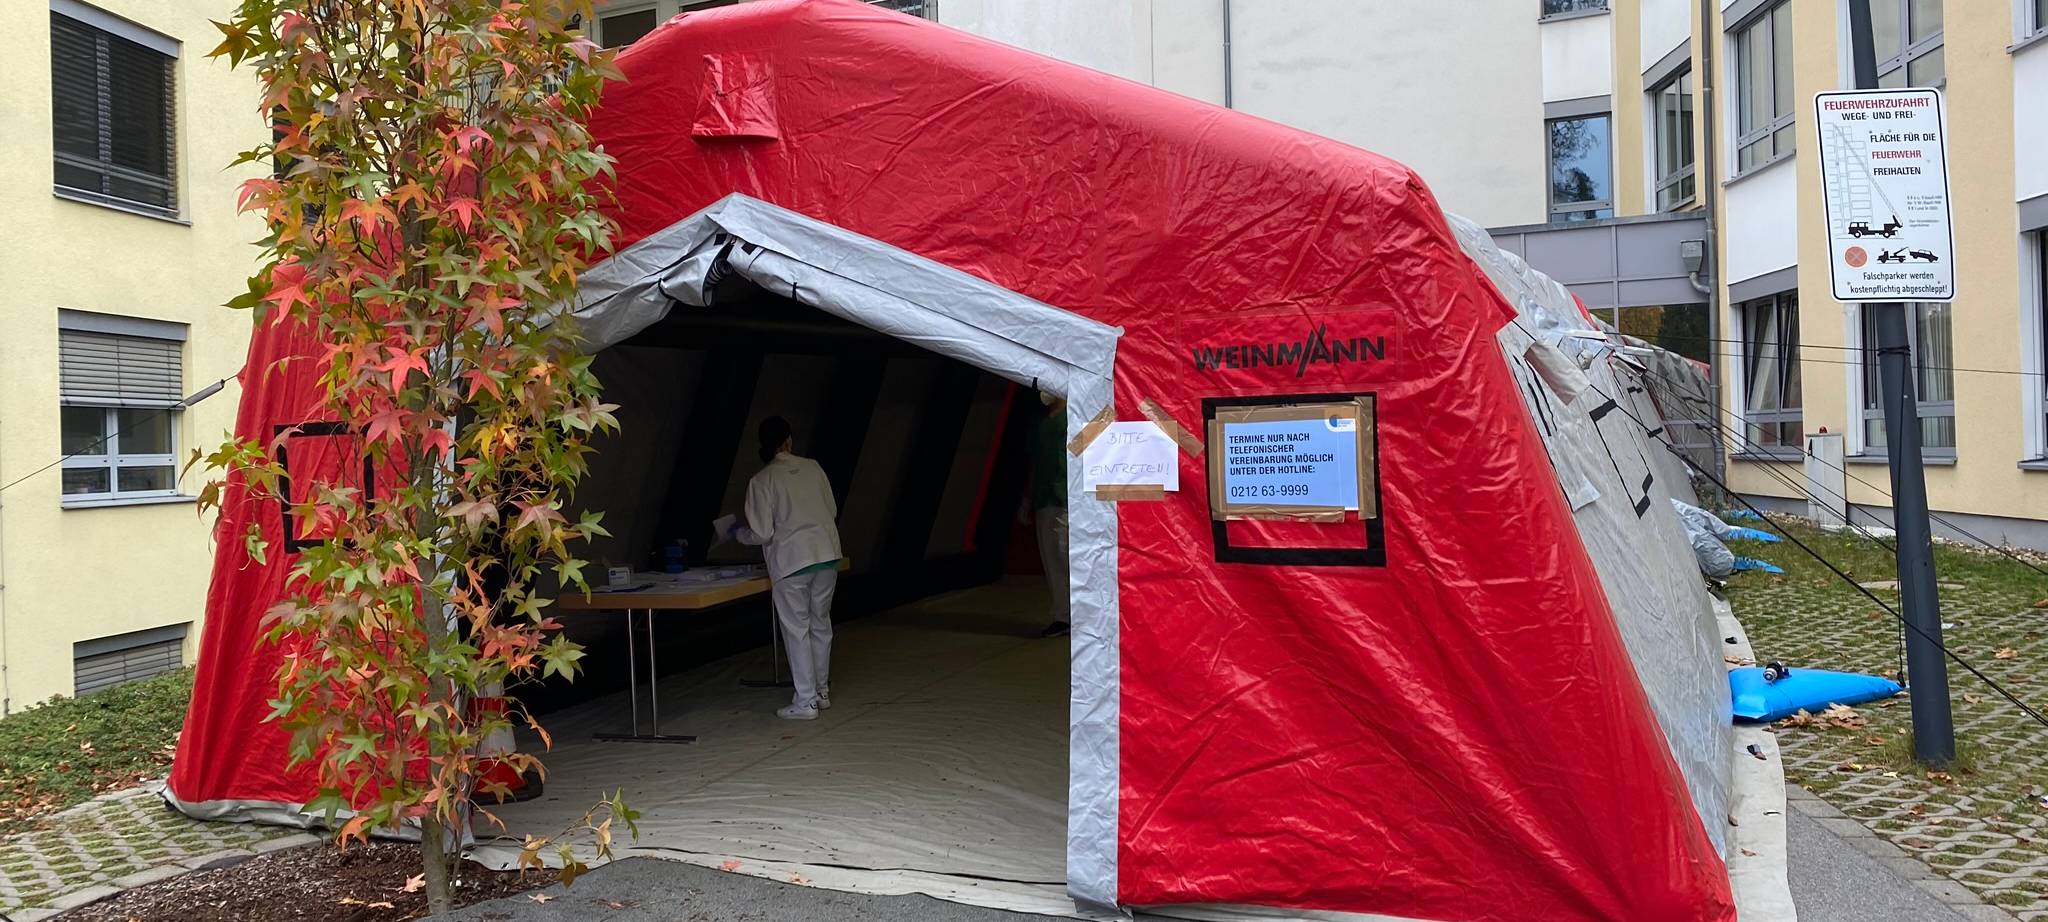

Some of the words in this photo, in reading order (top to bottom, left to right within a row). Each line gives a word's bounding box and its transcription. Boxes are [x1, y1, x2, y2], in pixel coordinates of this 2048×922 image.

[1824, 98, 1930, 110] FEUERWEHRZUFAHRT
[1841, 112, 1869, 120] WEGE-
[1872, 111, 1892, 120] UND
[1895, 111, 1917, 119] FREI-
[1870, 132, 1901, 143] FLÄCHE
[1903, 132, 1920, 142] FÜR
[1923, 133, 1936, 141] DIE
[1872, 150, 1922, 159] FEUERWEHR
[1873, 167, 1921, 176] FREIHALTEN
[1863, 272, 1907, 281] Falschparker
[1909, 272, 1934, 280] werden
[1850, 285, 1900, 294] kostenpflichtig
[1902, 284, 1948, 294] abgeschleppt!
[1192, 322, 1385, 378] WEINMANN
[1106, 432, 1148, 444] BITTE
[1229, 435, 1265, 444] TERMINE
[1267, 434, 1284, 442] NUR
[1287, 433, 1310, 441] NACH
[1230, 444, 1294, 454] TELEFONISCHER
[1230, 455, 1293, 465] VEREINBARUNG
[1295, 453, 1333, 463] MÖGLICH
[1230, 467, 1256, 475] UNTER
[1259, 466, 1275, 475] DER
[1278, 465, 1315, 474] HOTLINE:
[1231, 486, 1258, 497] 0212
[1261, 485, 1309, 496] 63-9999
